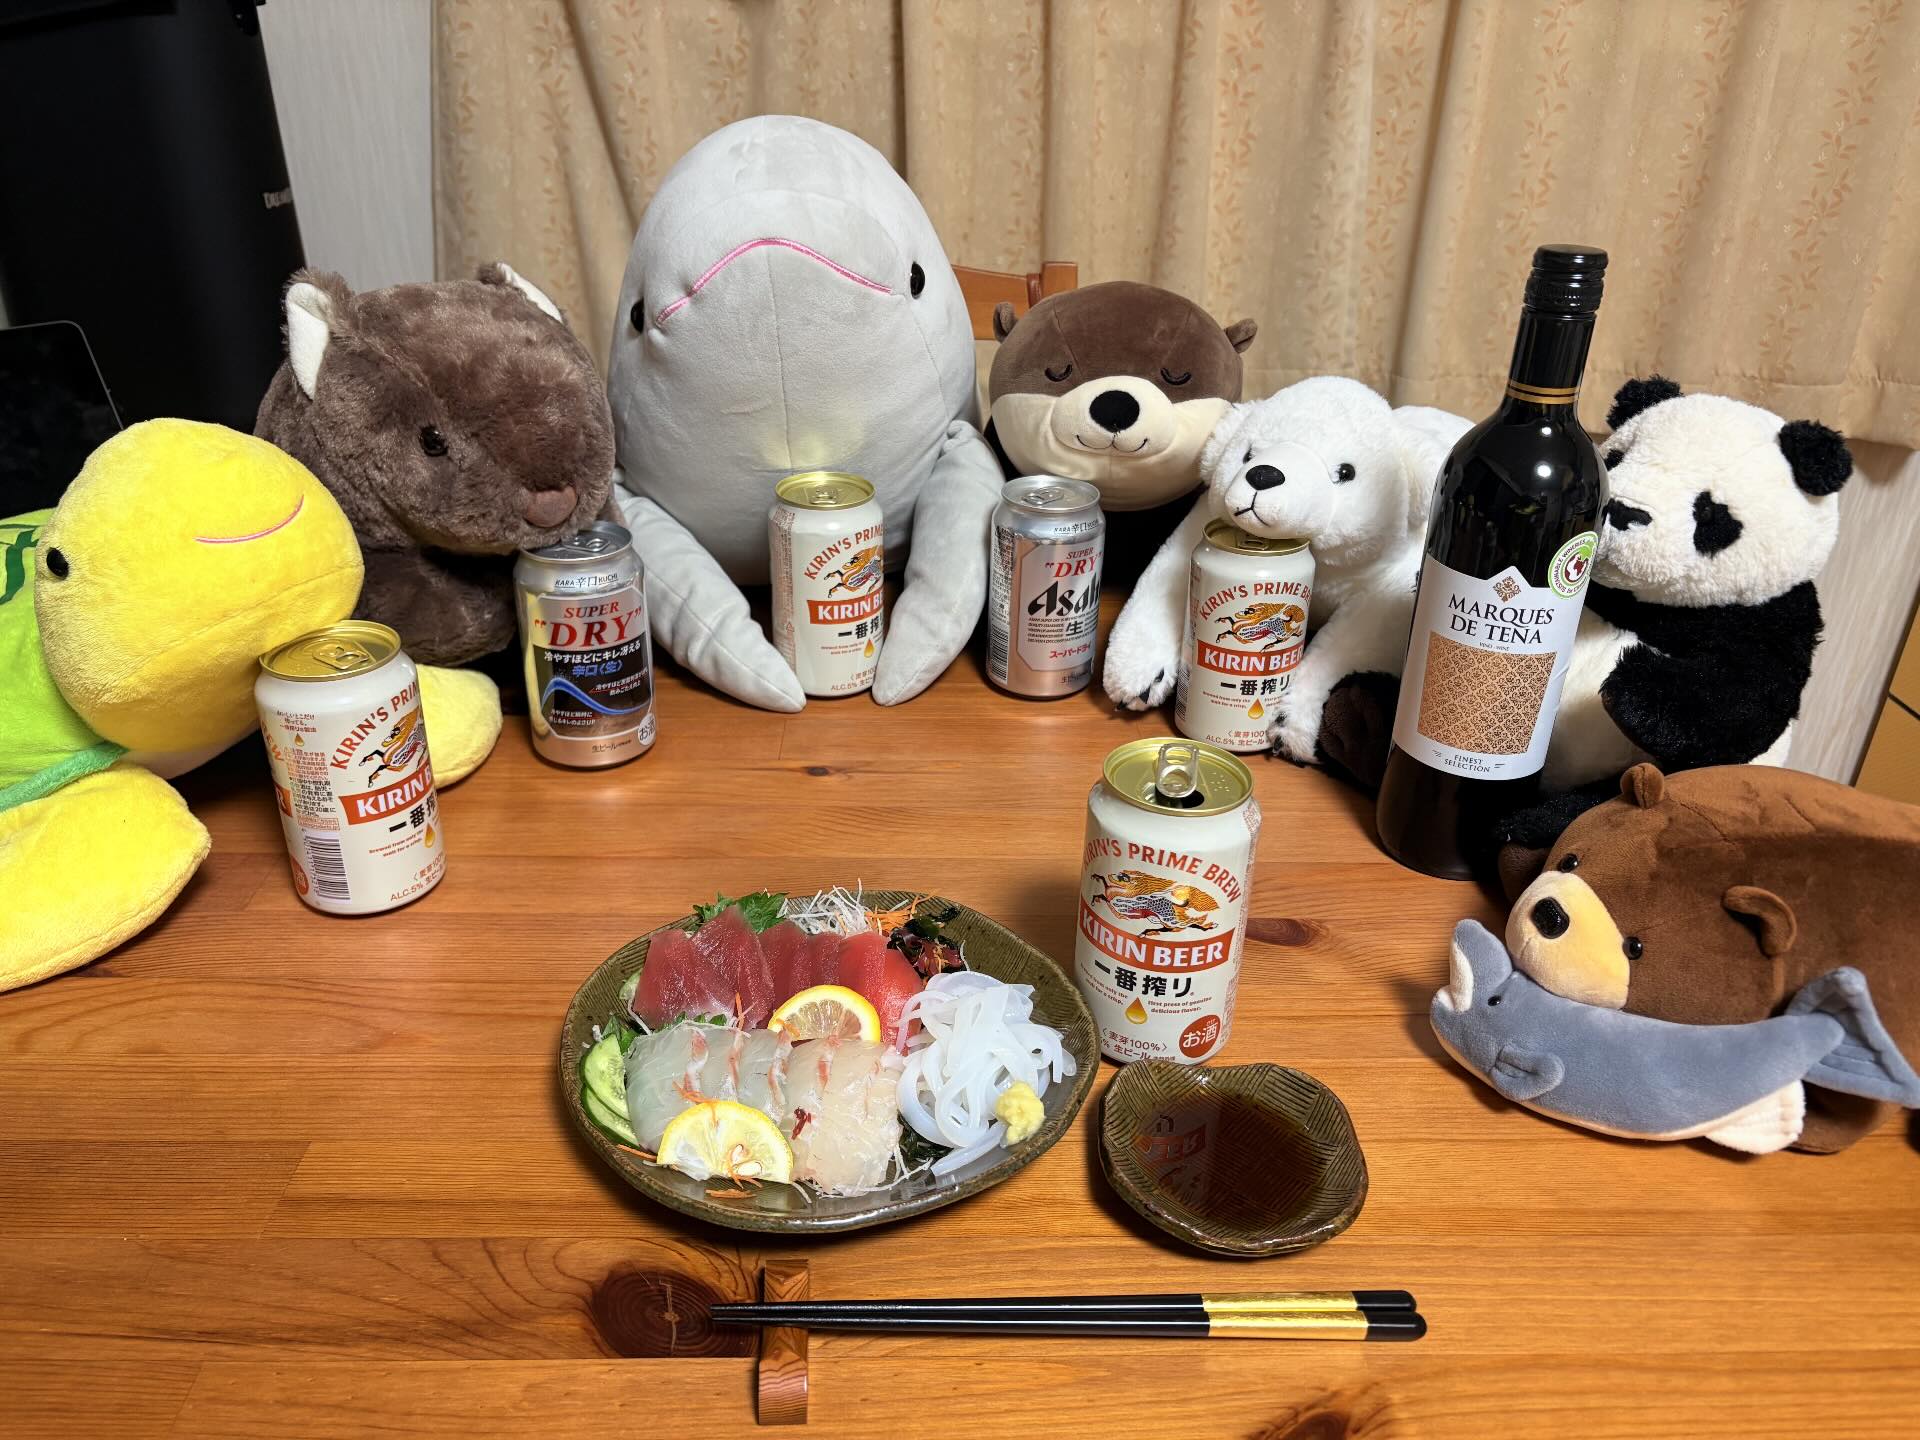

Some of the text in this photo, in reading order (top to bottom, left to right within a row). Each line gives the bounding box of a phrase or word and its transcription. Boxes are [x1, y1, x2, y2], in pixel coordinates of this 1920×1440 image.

[804, 537, 852, 580] KIRIN'S
[1067, 547, 1093, 559] SUPER
[576, 576, 597, 588] 辛口
[564, 601, 620, 619] SUPER
[818, 597, 870, 620] KIRIN
[1200, 584, 1249, 620] KIRIN'S
[1253, 582, 1302, 596] PRIME
[1448, 593, 1555, 628] MARQUÉS
[1066, 620, 1083, 636] 生
[1449, 613, 1542, 645] DE TENA
[1204, 648, 1265, 671] KIRIN
[1220, 674, 1290, 695] 一番搾り
[330, 706, 389, 770] KIRIN'S
[1444, 758, 1491, 773] SELECTION
[1454, 754, 1484, 765] FINEST
[356, 773, 425, 818] KIRIN
[1127, 842, 1203, 875] PRIME
[1202, 863, 1242, 903] BREW
[1082, 908, 1224, 967] KIRIN BEER
[1094, 959, 1192, 998] 一番搾り
[1182, 1022, 1217, 1048] お酒
